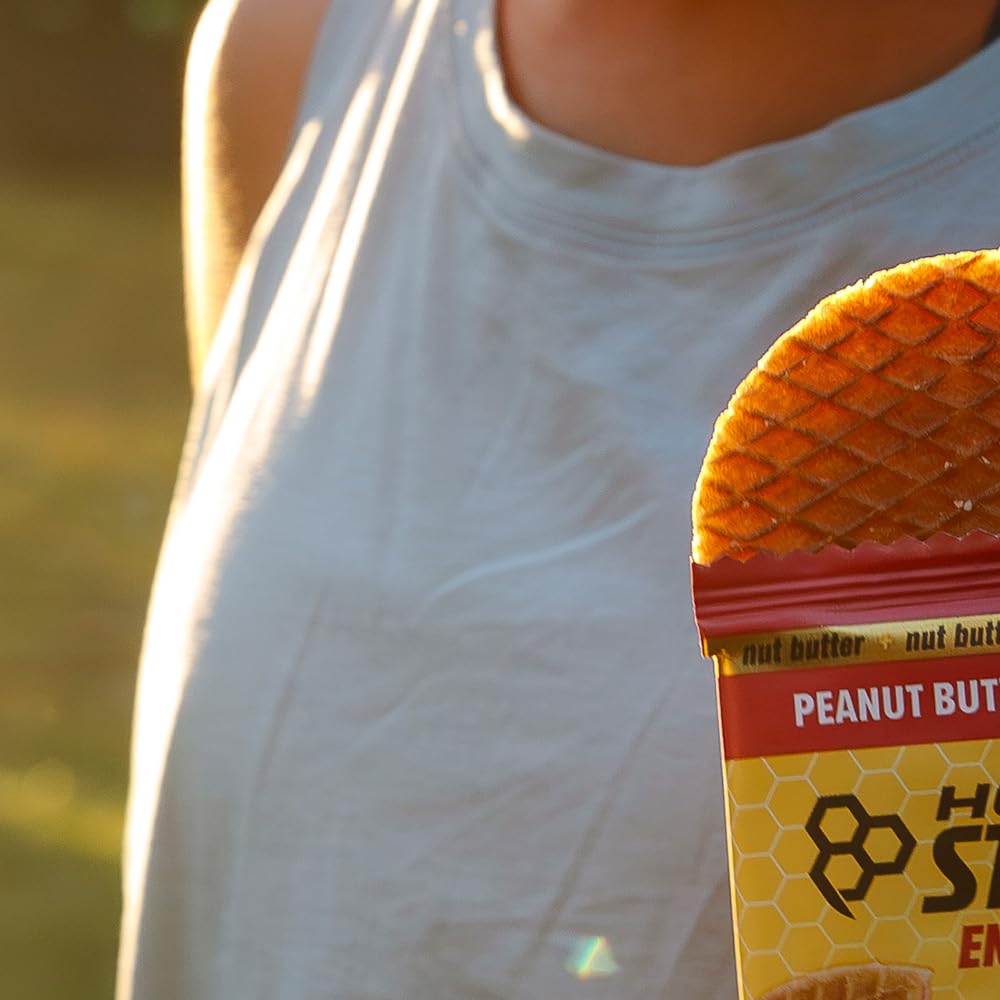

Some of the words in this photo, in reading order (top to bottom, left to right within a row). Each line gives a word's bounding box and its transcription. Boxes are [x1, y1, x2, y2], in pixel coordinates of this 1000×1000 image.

[743, 637, 782, 666] nut
[790, 632, 865, 661] butter
[905, 625, 946, 652] nut
[793, 683, 924, 727] PEANUT
